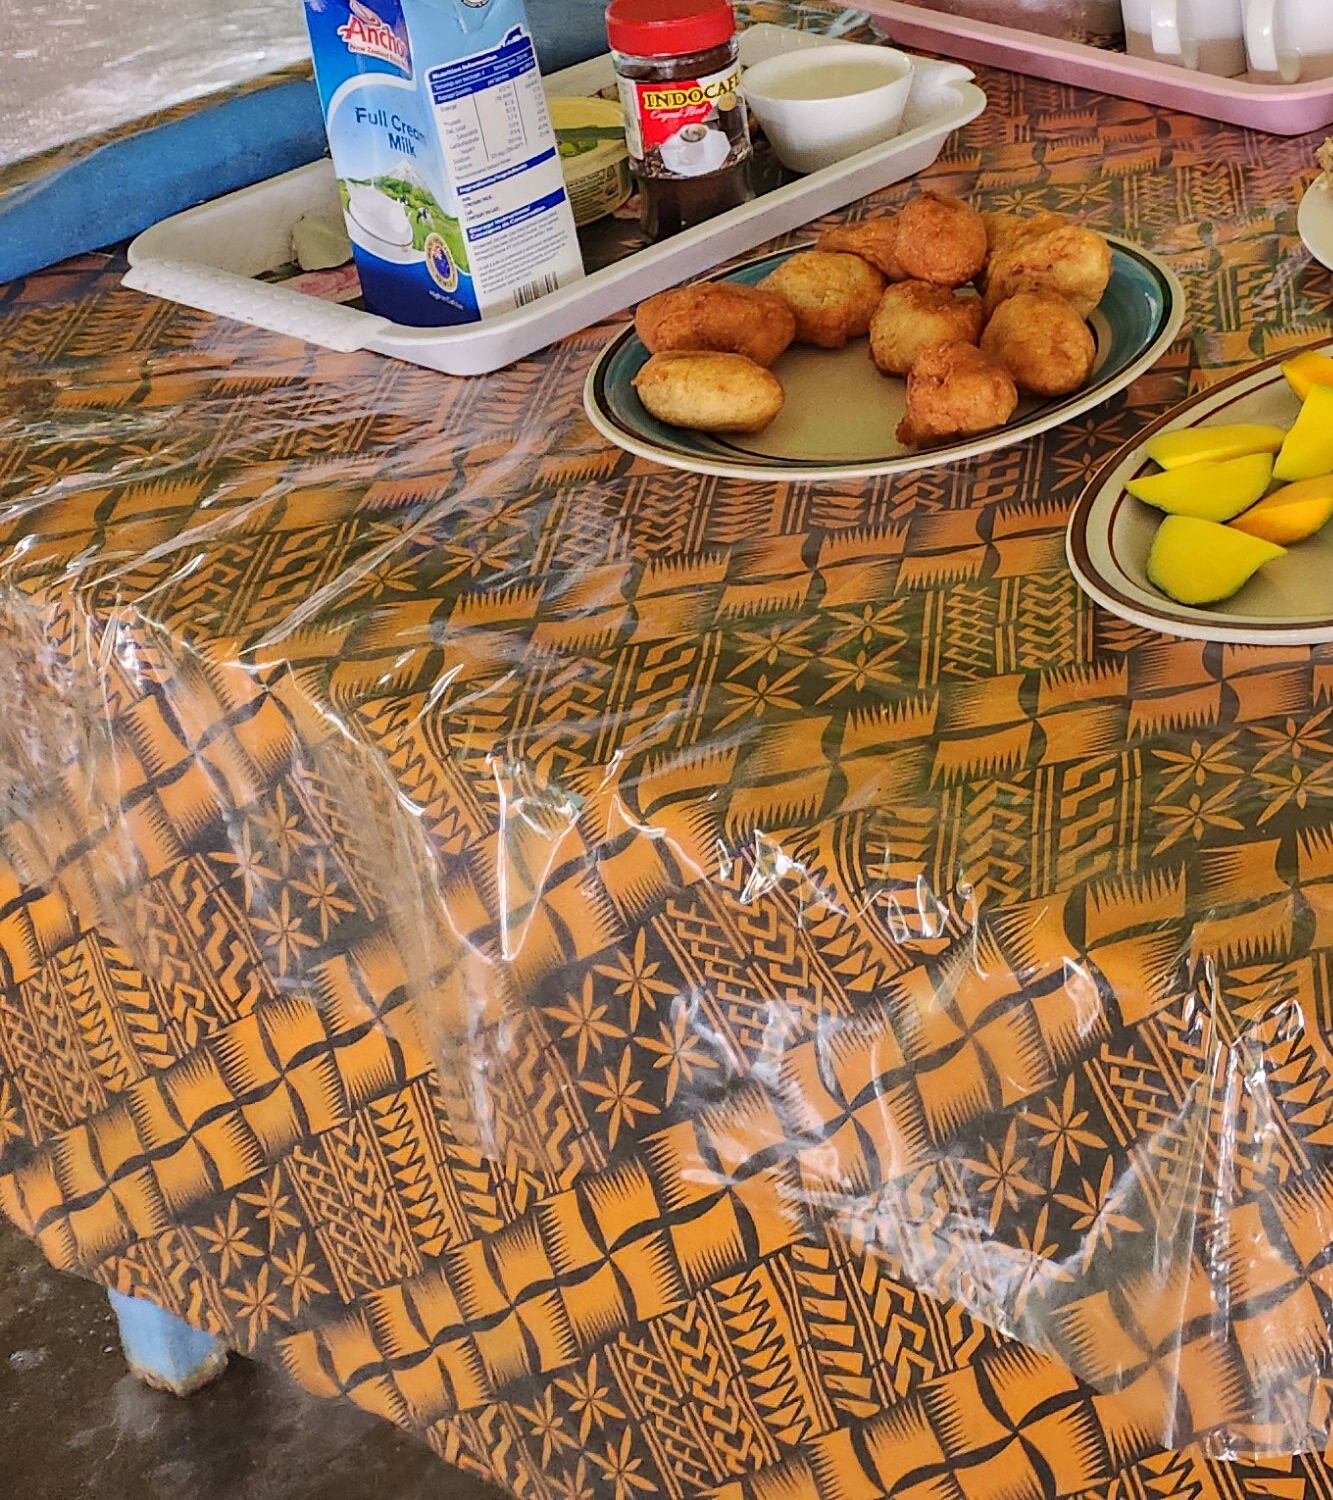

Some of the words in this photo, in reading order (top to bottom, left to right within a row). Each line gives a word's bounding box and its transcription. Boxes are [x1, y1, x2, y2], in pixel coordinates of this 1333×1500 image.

[340, 15, 407, 58] Ancho
[355, 106, 388, 128] Full
[388, 132, 417, 158] Milk
